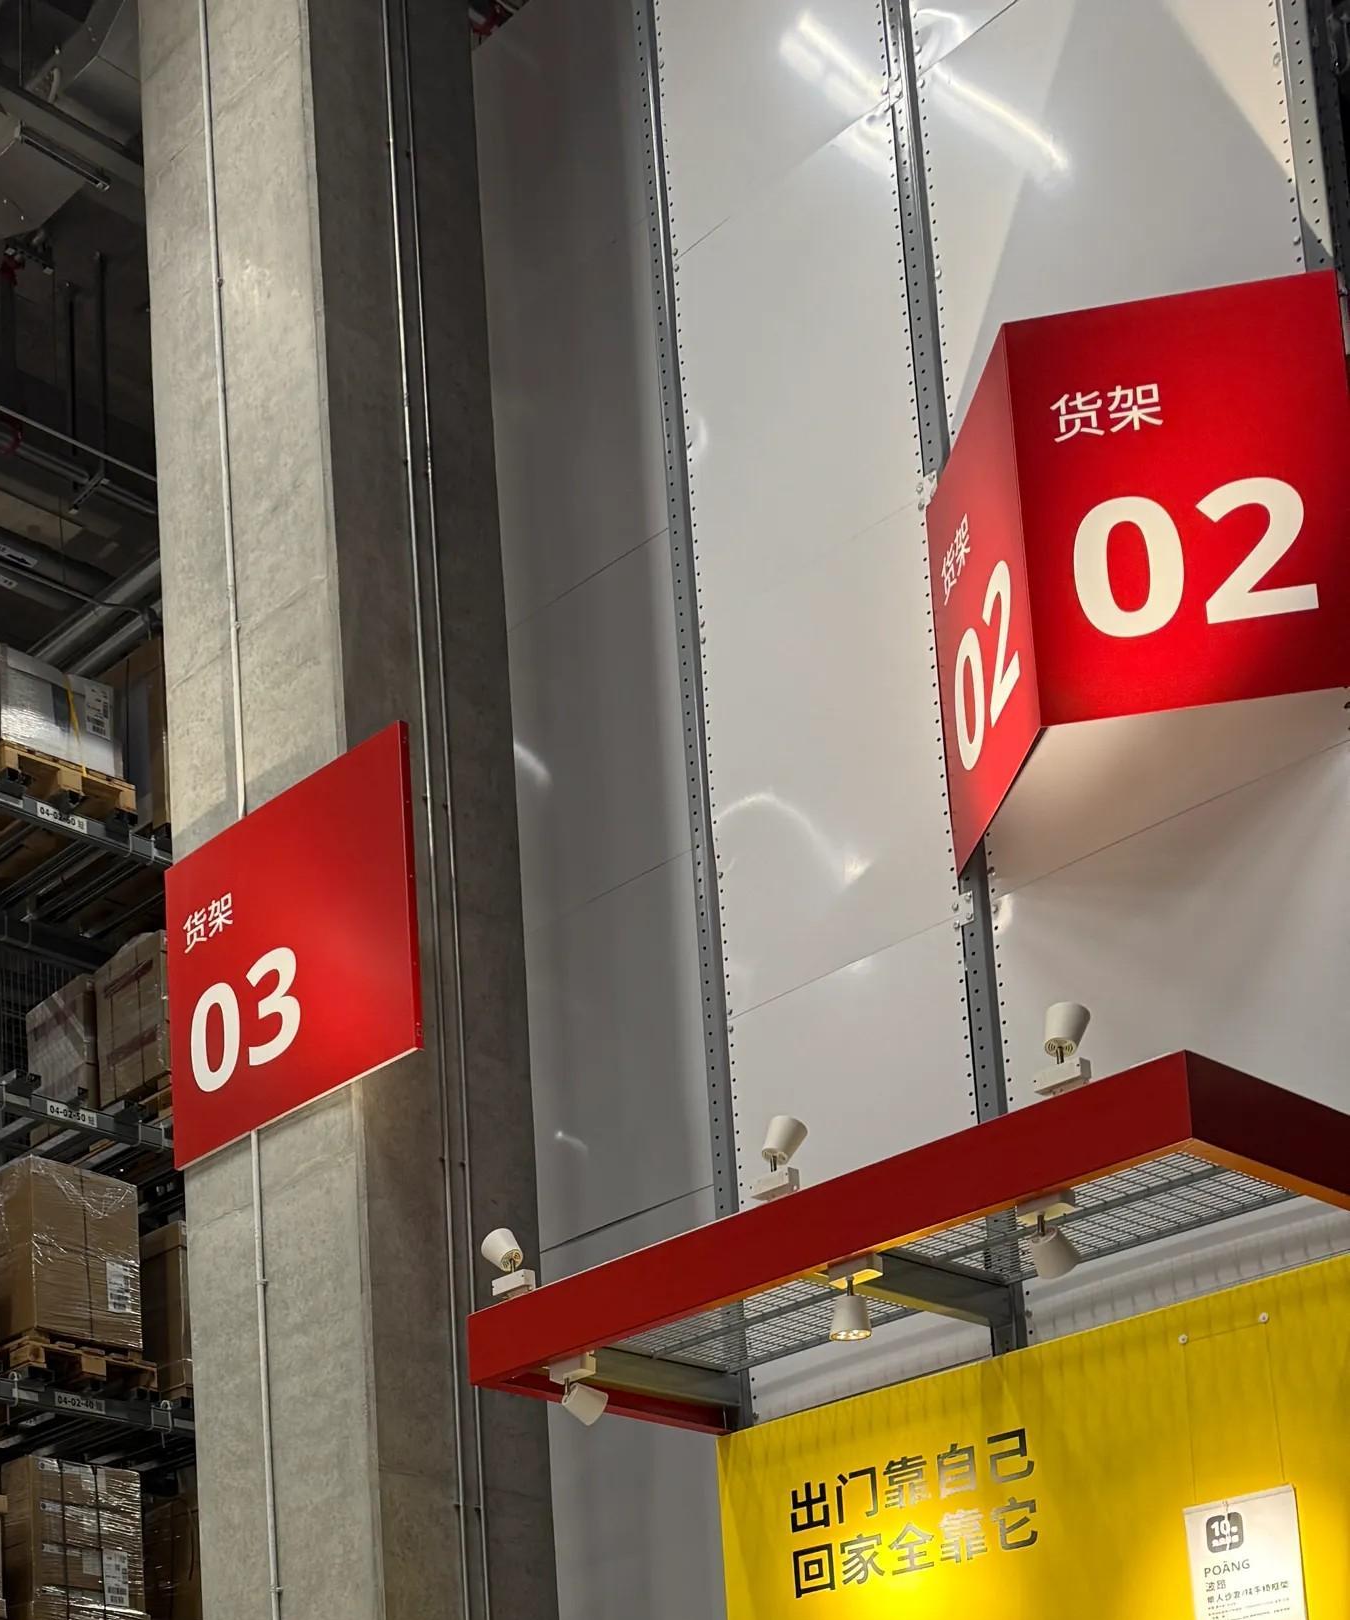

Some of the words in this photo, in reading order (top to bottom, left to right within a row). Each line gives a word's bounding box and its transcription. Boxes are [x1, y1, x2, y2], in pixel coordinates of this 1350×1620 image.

[1051, 383, 1163, 442] 货架
[940, 513, 971, 606] 货架
[1073, 476, 1319, 638] 02
[954, 560, 1021, 771] 02
[183, 893, 233, 953] 货架
[190, 947, 301, 1093] 03
[49, 1103, 86, 1122] 04-02-50
[57, 1395, 94, 1410] 04-02-40
[790, 1428, 1035, 1533] 出门靠自己
[792, 1496, 1038, 1599] 回家全靠它
